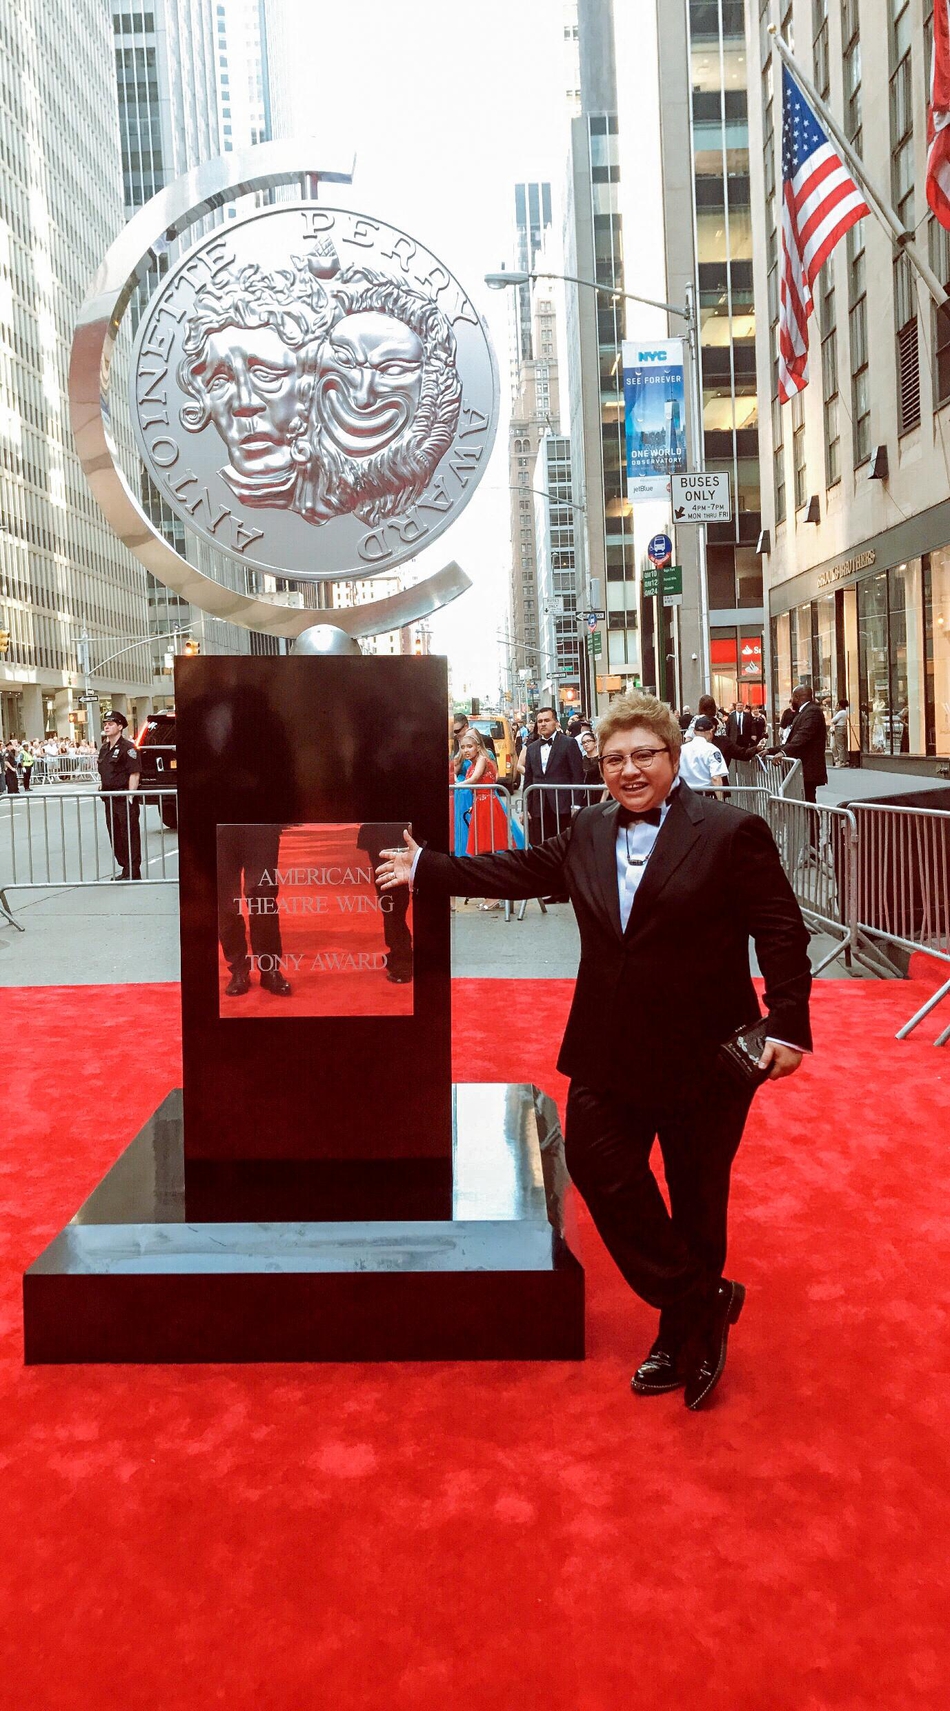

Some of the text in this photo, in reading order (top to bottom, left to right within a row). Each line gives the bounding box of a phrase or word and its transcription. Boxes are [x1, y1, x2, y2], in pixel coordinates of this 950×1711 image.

[638, 350, 668, 362] NYC
[138, 212, 489, 561] ANTOINETTE PERRY AWARD
[626, 375, 682, 386] SEE FOREVER
[631, 447, 682, 459] ONE WORLD
[631, 457, 682, 466] OBSERVATORY
[680, 476, 720, 488] BUSES
[633, 484, 654, 494] jetBlue
[685, 490, 716, 501] ONLY
[257, 867, 373, 887] AMERICAN
[233, 895, 395, 916] THEATRE WING
[245, 952, 388, 972] TONY AWARD
